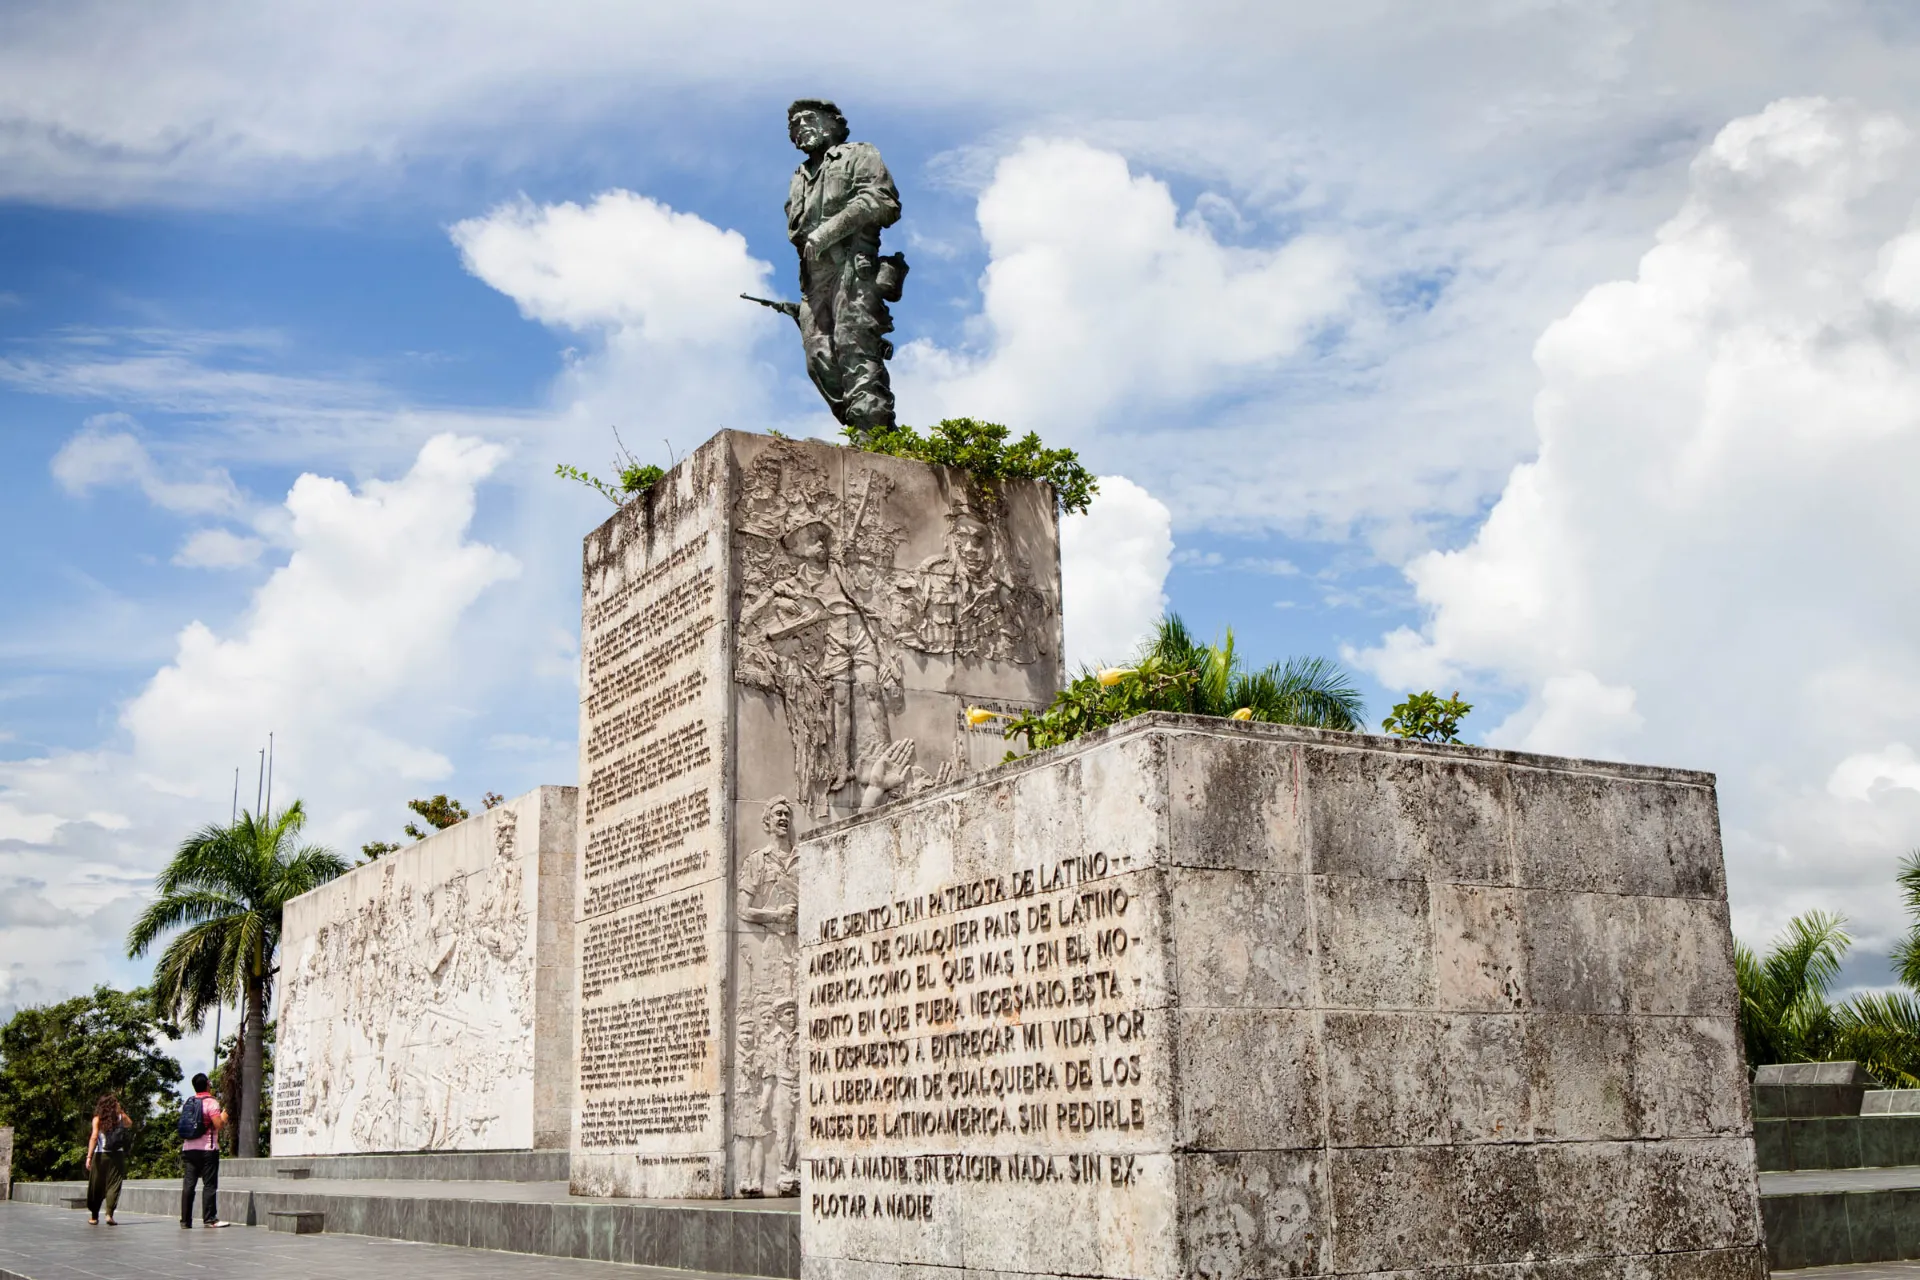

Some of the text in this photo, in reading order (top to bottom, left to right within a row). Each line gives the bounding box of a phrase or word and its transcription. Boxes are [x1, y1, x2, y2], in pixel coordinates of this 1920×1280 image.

[843, 905, 891, 936] SIENTO
[896, 896, 923, 924] TAN
[928, 876, 1006, 917] PATRIOTA
[1012, 869, 1034, 898] DE
[809, 945, 869, 977] AMERICA,
[872, 939, 890, 965] DE
[895, 919, 979, 960] CUALQUIER
[985, 910, 1020, 941] PAIS
[1028, 903, 1051, 934] DE
[869, 968, 911, 999] COMO
[917, 963, 937, 991] EL
[942, 956, 974, 991] QUE
[980, 948, 1015, 980] MAS
[1066, 934, 1090, 965] EL
[809, 1014, 853, 1042] MENTO
[858, 1009, 876, 1036] EN
[880, 1005, 909, 1036] QUE
[916, 997, 964, 1026] FUERA
[809, 1010, 1146, 1074] RIA DISPUESTO A ENTREGAR MI VIDA POR
[809, 1054, 1141, 1106] LA LIBERACION DE CUALQUIERA DE LOS
[810, 1098, 1145, 1141] PAISES DE LATINOAMERICA, SIN PEDIRLE
[811, 1156, 846, 1182] NADA
[852, 1157, 861, 1179] A
[915, 1157, 938, 1183] SIN
[944, 1154, 1002, 1184] EXIGIR
[1069, 1154, 1101, 1184] SIN
[812, 1194, 933, 1221] PLOTAR A NADIE
